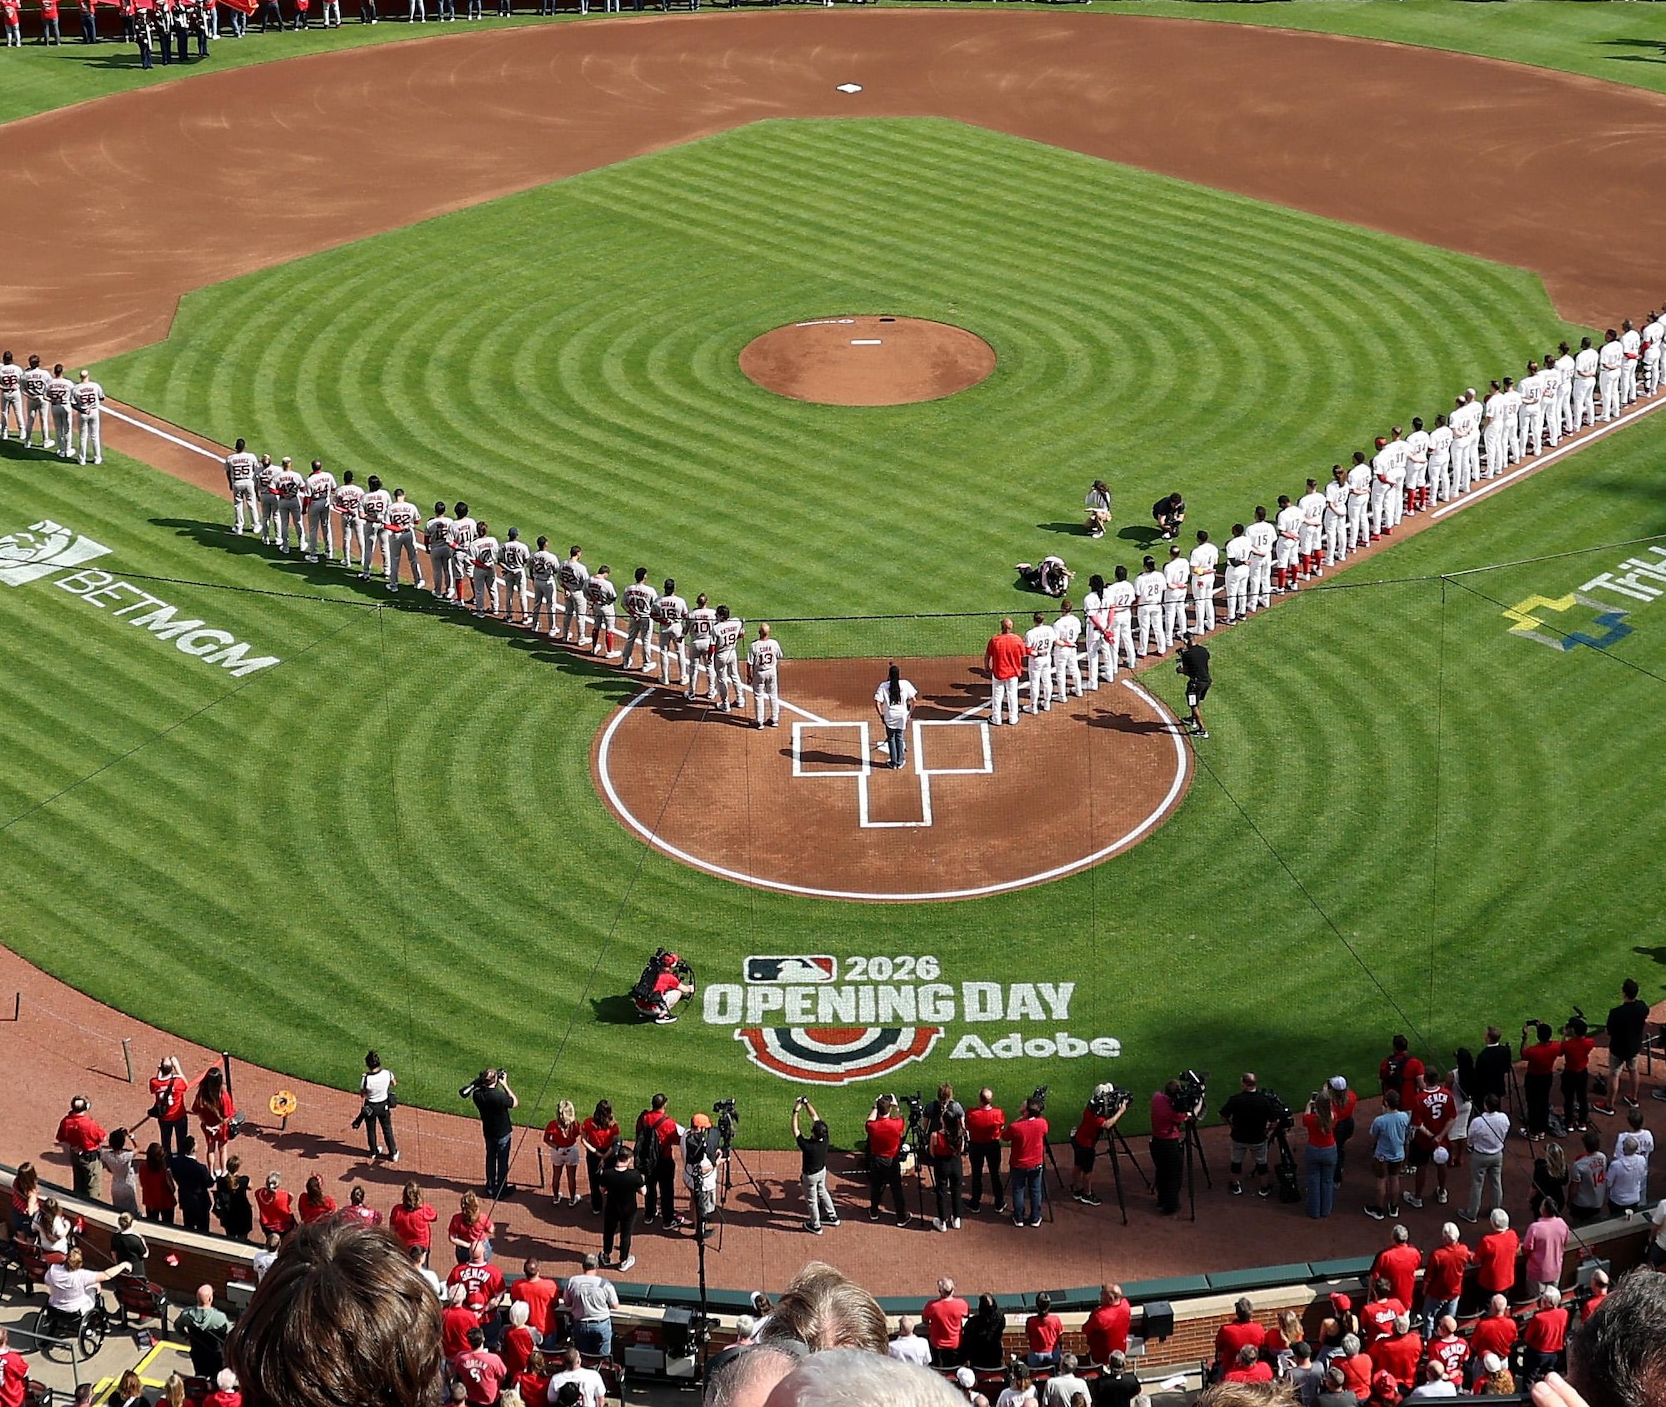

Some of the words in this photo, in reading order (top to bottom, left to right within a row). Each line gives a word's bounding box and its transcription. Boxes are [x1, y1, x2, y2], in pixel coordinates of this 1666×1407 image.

[54, 566, 281, 678] BETMGM
[844, 955, 941, 982] 2026
[702, 982, 957, 1025] OPENING
[962, 981, 1076, 1023] DAY
[949, 1031, 1122, 1059] Adobe
[1432, 1104, 1442, 1120] 5
[468, 1280, 481, 1295] 5
